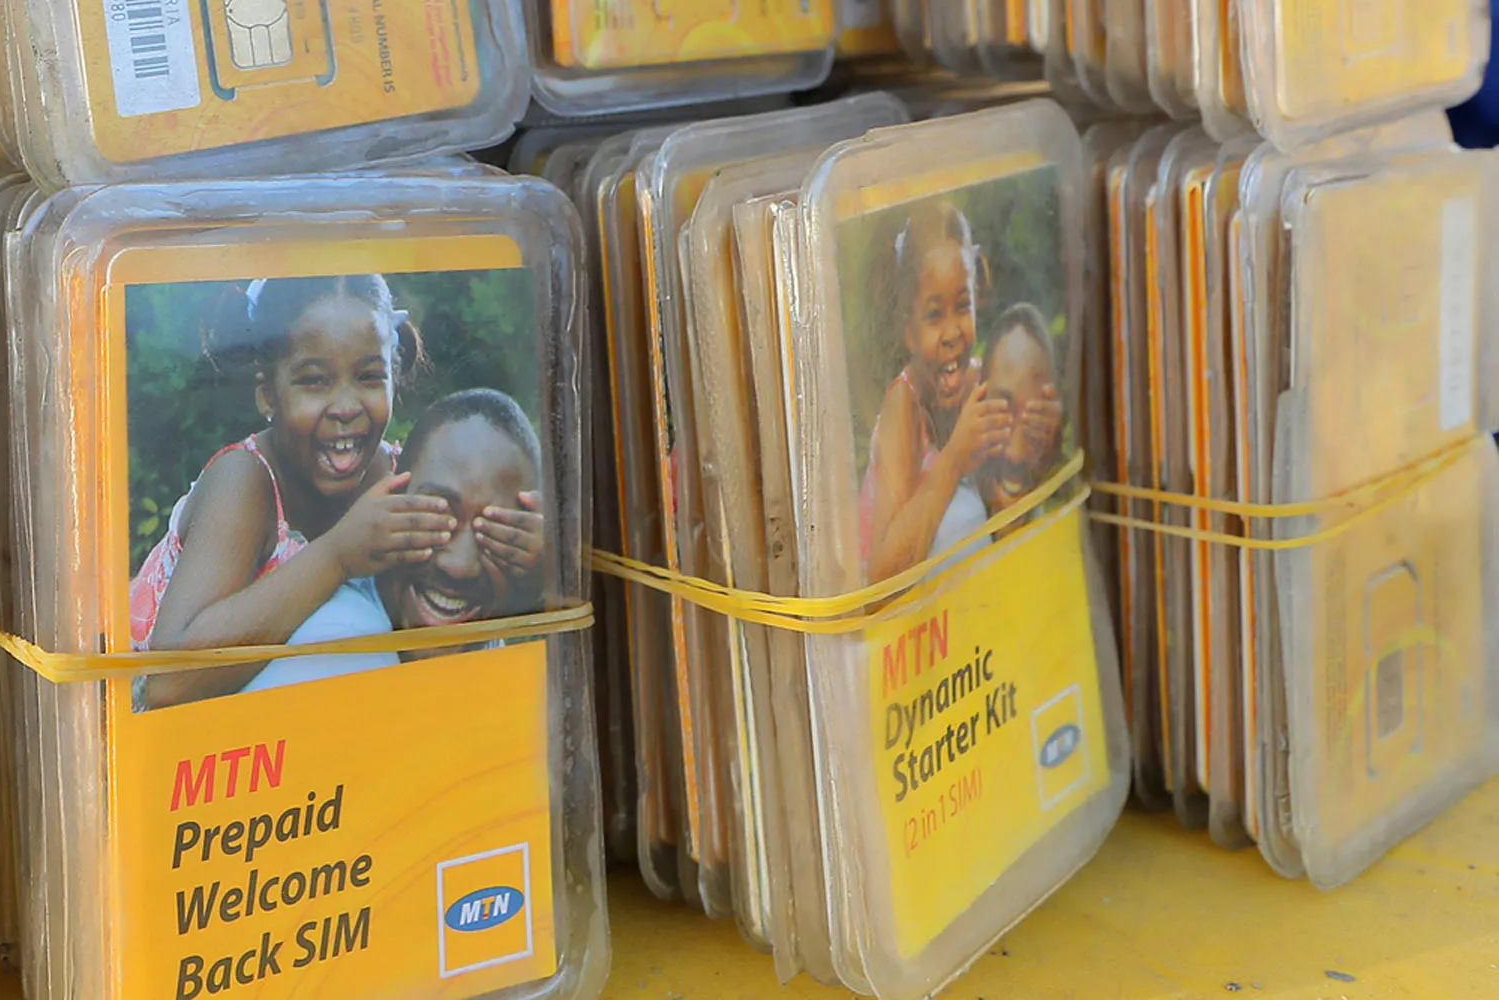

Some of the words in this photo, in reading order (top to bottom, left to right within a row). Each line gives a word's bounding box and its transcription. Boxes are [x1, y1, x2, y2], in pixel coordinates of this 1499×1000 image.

[374, 14, 394, 79] NUMBER
[383, 79, 396, 94] IS
[882, 608, 949, 700] MTN
[884, 645, 994, 752] Dynamic
[169, 738, 287, 812] MTN
[892, 711, 980, 803] Starter
[985, 680, 1018, 736] Kit
[170, 784, 346, 870] Prepaid
[921, 808, 937, 840] in
[948, 766, 984, 818] SIM)
[174, 852, 374, 936] Welcome
[458, 891, 511, 927] MTN
[173, 927, 284, 1000] Back
[291, 906, 372, 970] SIM
